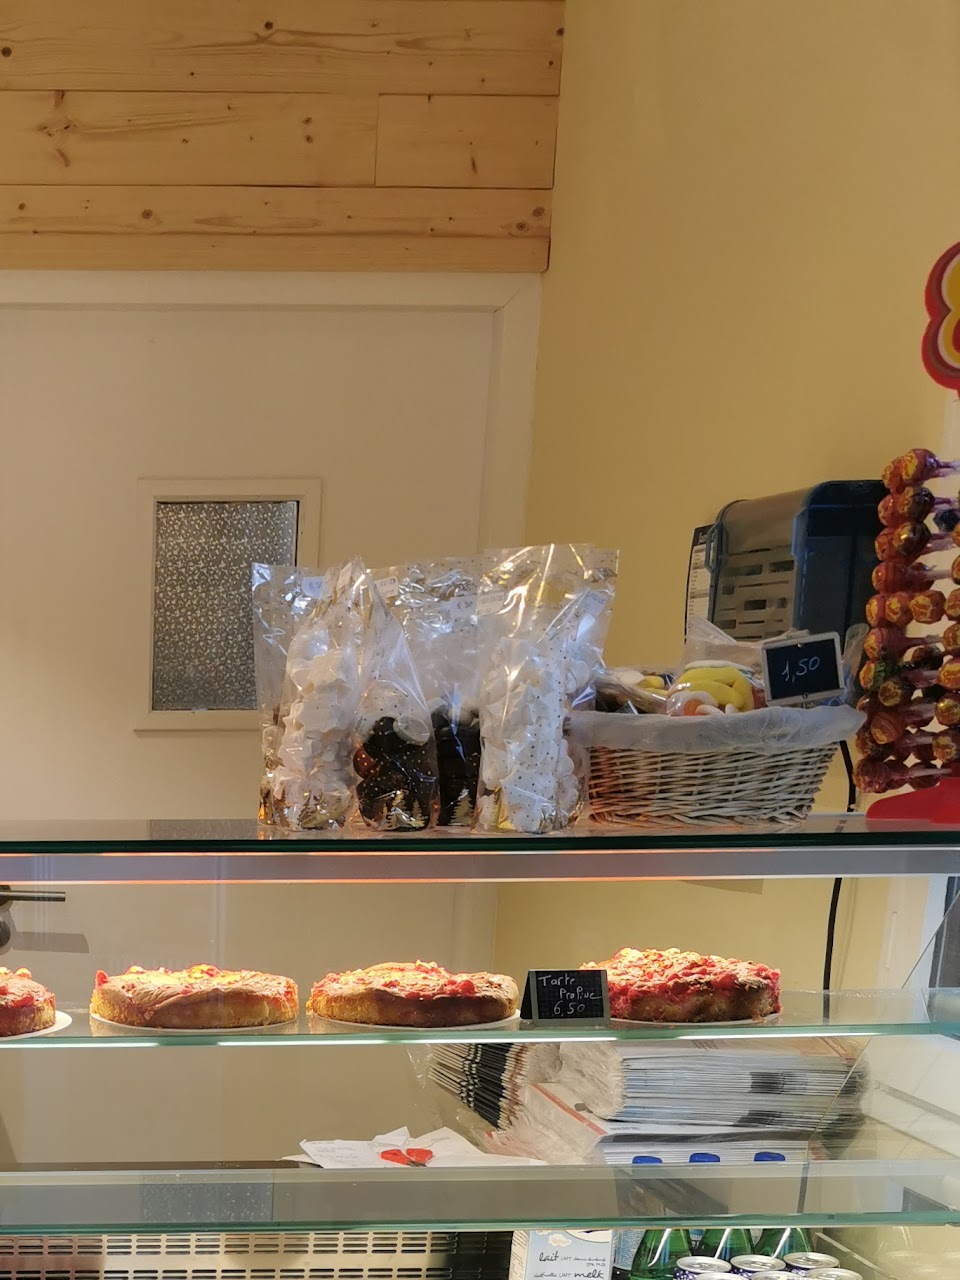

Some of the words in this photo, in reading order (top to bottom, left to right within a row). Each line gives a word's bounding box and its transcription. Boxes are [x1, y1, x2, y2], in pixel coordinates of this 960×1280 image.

[781, 656, 820, 684] 1,50
[538, 972, 576, 987] Tarte
[539, 1250, 559, 1262] lait
[574, 1269, 604, 1280] melk
